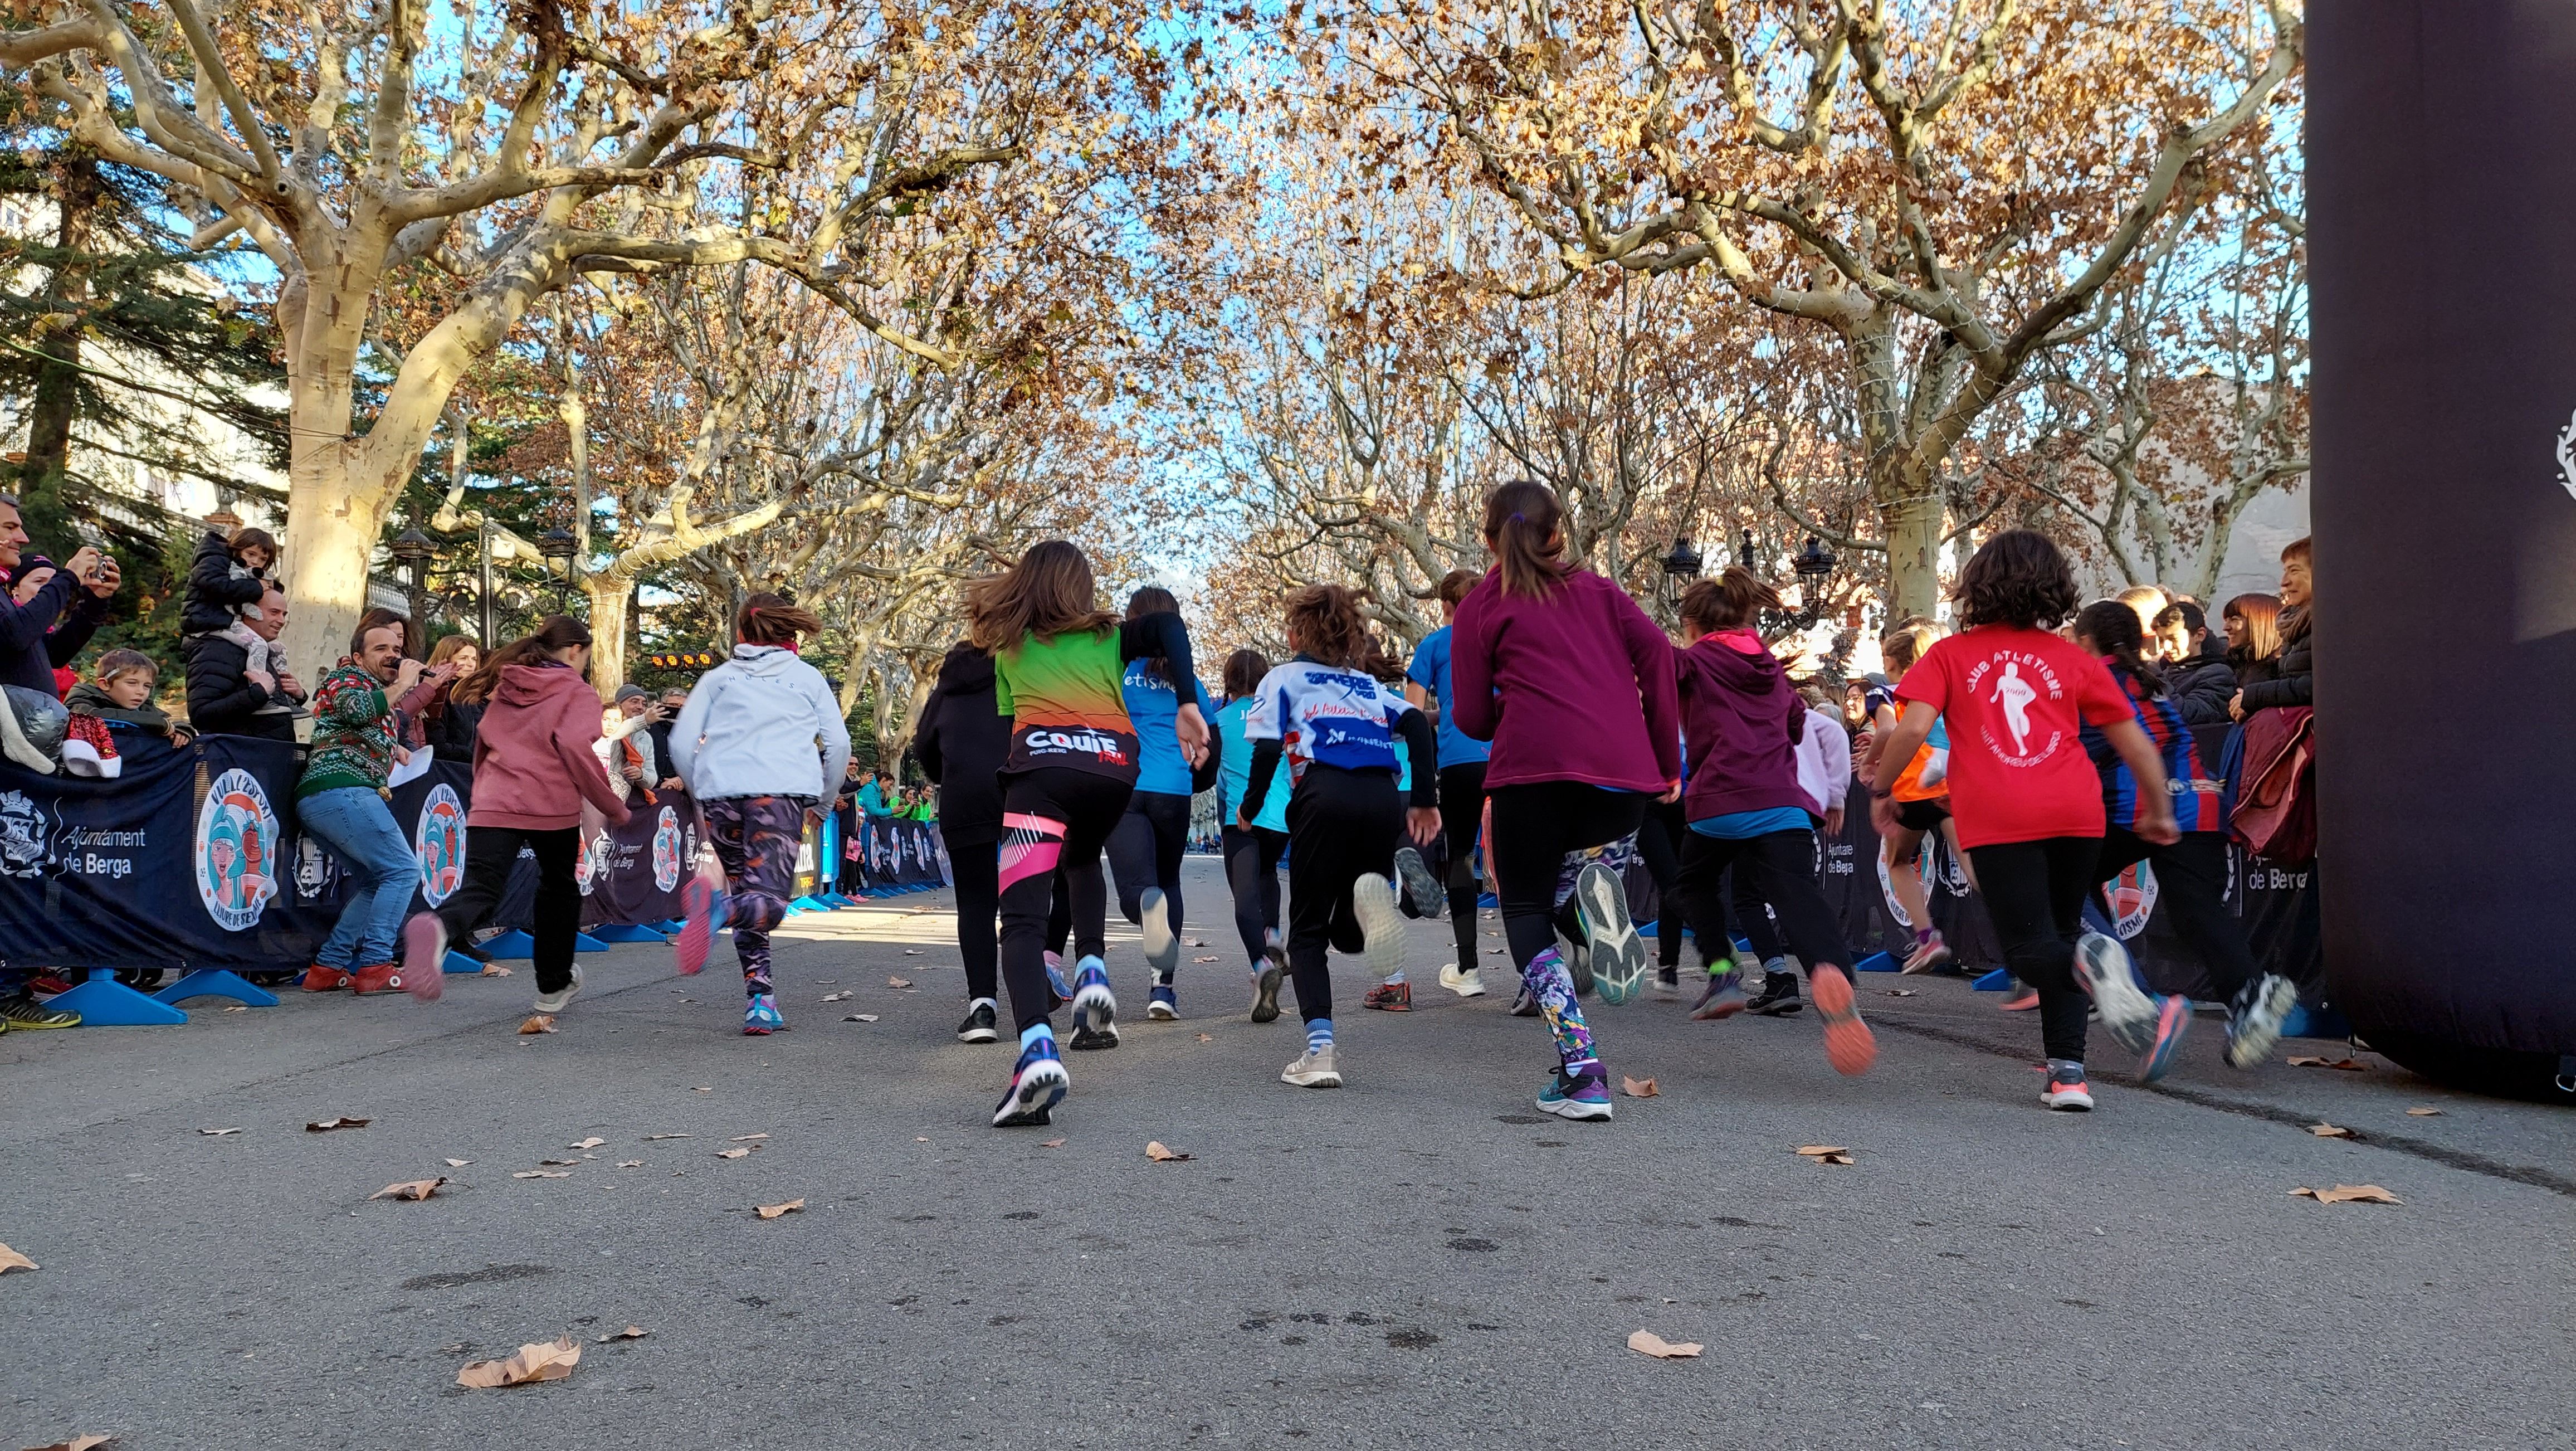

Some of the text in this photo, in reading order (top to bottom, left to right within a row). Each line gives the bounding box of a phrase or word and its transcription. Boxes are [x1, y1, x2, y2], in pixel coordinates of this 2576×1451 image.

[1967, 650, 2063, 702] CLUB ATLETISME
[1029, 748, 1067, 757] PUIG-REIG
[211, 776, 237, 805] VULL
[61, 826, 146, 850] Ajuntament
[63, 852, 131, 879] de Berga
[1827, 860, 1836, 873] de
[2249, 869, 2265, 889] de
[213, 900, 232, 926] LLIURE
[232, 913, 240, 927] DE
[1891, 900, 1905, 921] LLIURE
